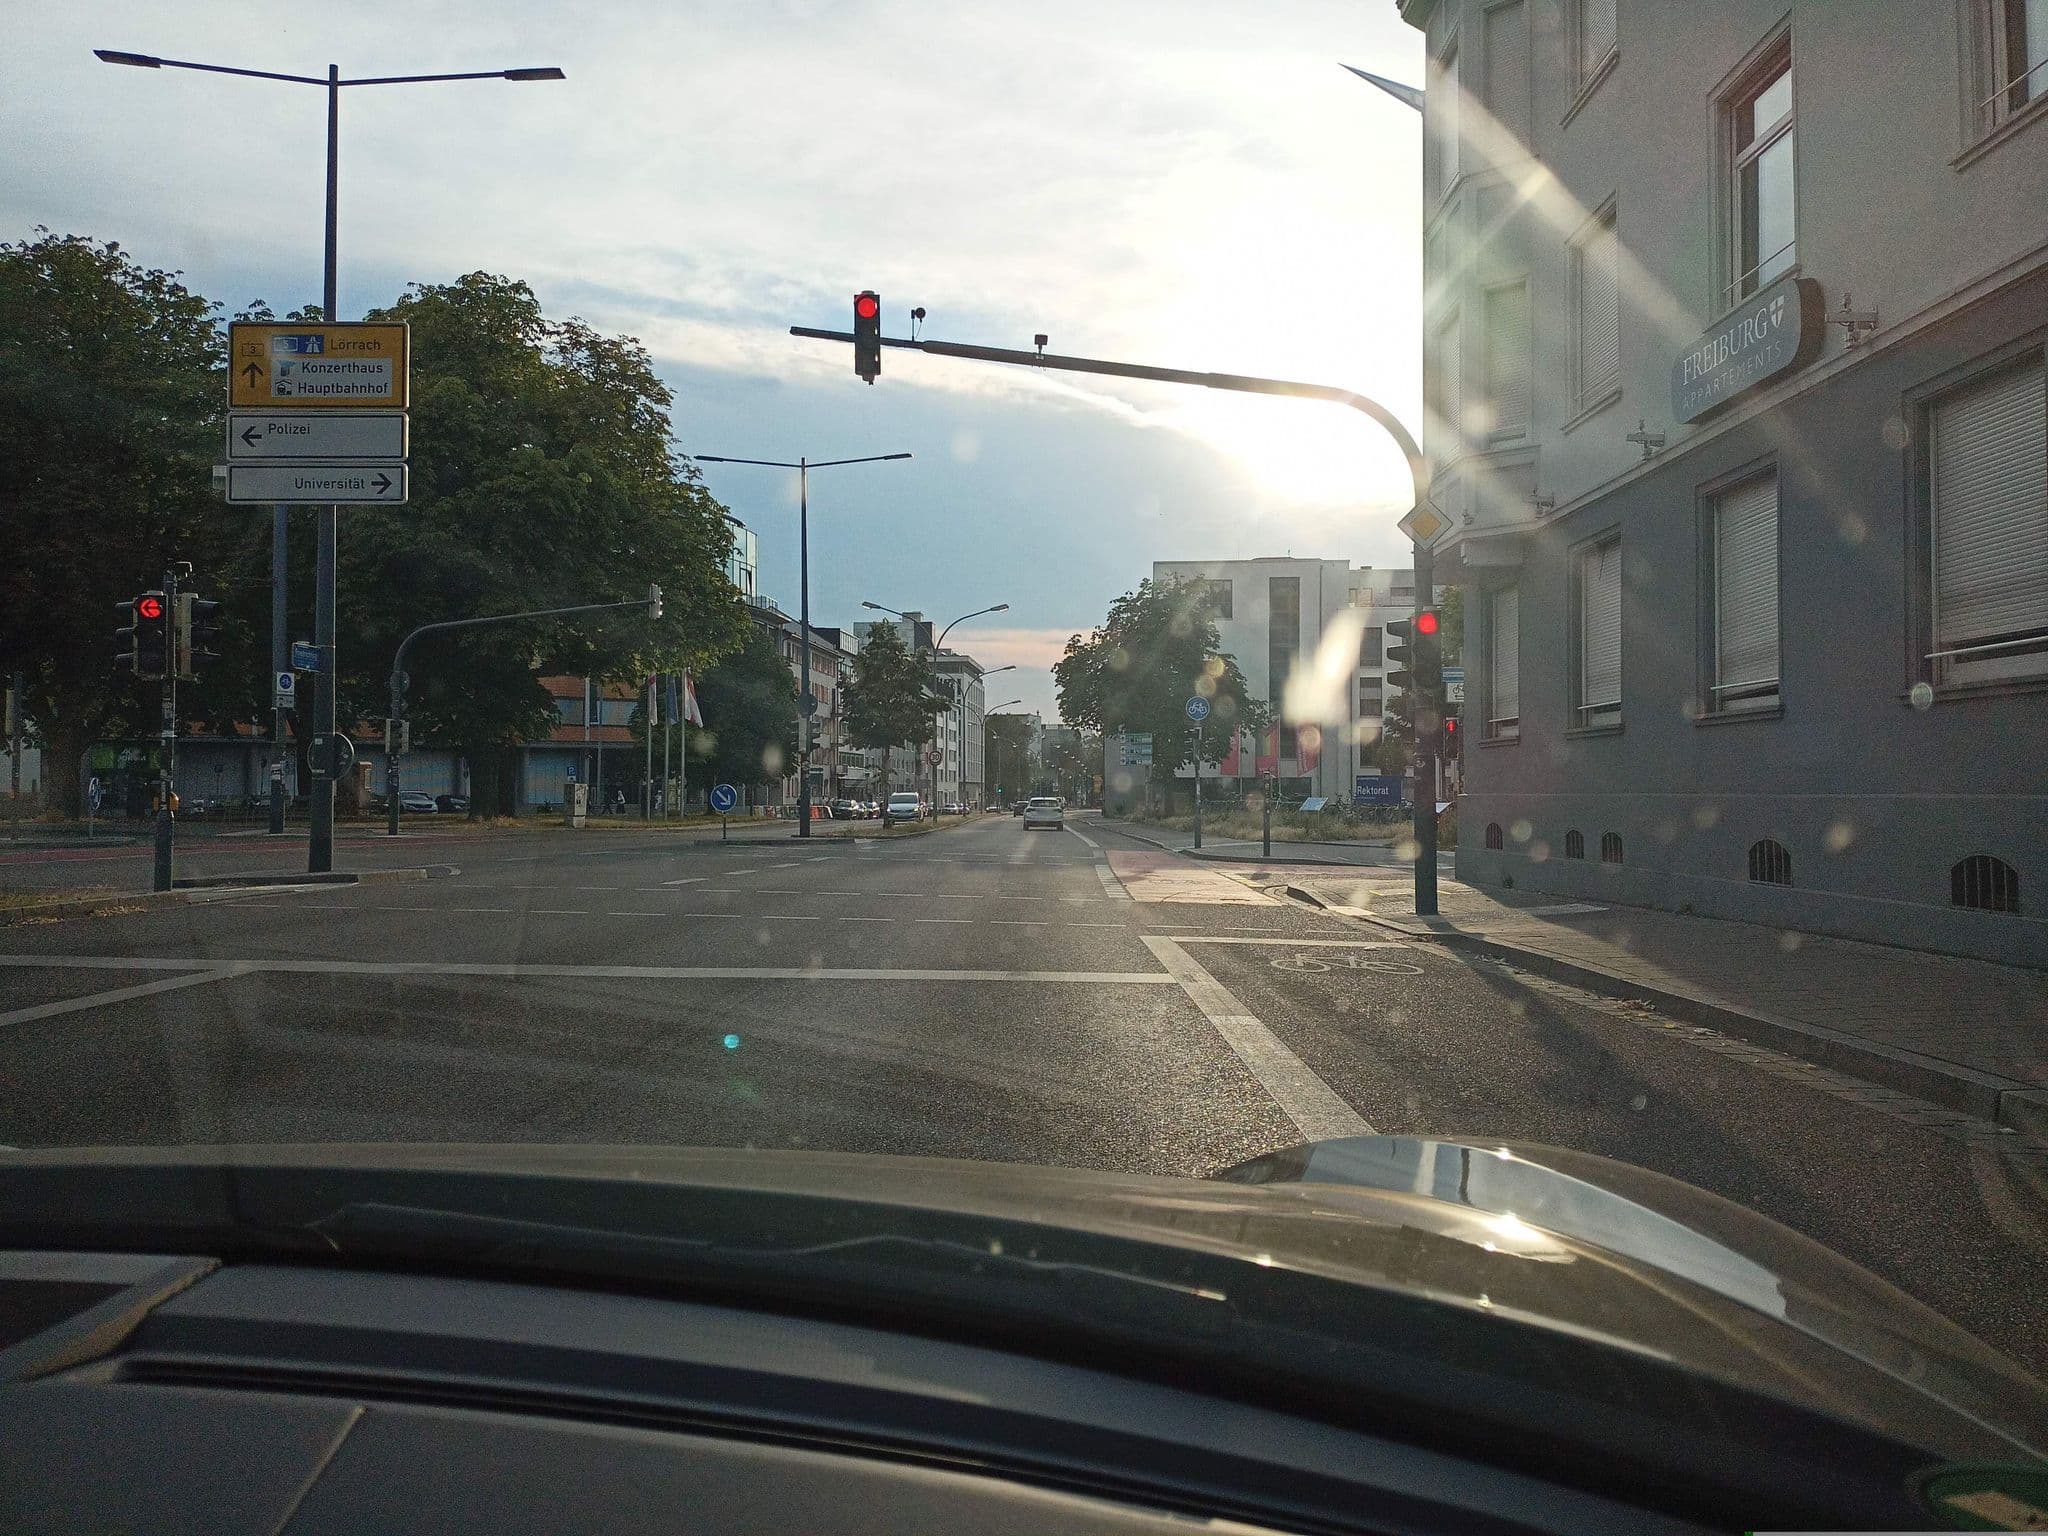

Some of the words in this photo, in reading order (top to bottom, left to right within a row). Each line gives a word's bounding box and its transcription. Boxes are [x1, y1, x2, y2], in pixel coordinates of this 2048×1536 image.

[249, 345, 256, 354] 3
[330, 338, 381, 351] Lörrach
[1682, 308, 1768, 386] FREIBURG
[301, 362, 383, 374] Konzerthaus
[298, 382, 389, 395] Hauptbahnhof
[268, 423, 311, 435] Polizei
[294, 477, 365, 490] Universität
[1357, 785, 1389, 795] Rektorat
